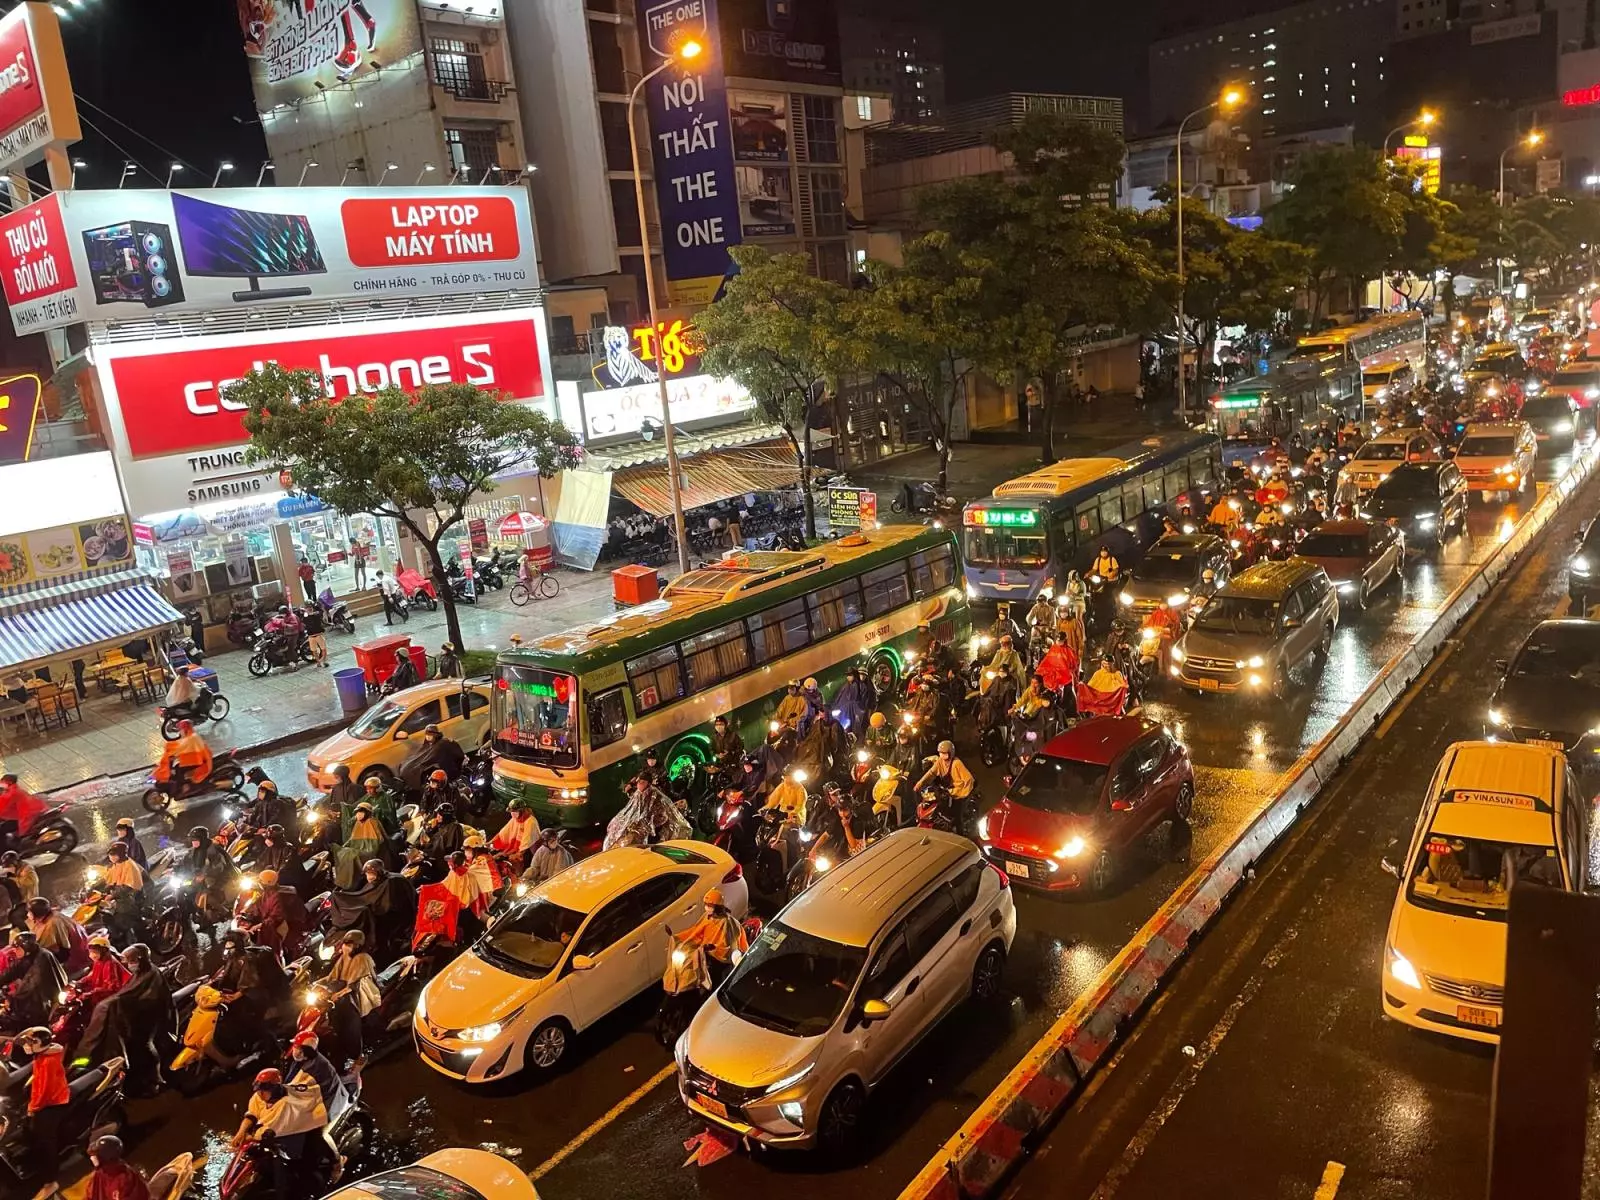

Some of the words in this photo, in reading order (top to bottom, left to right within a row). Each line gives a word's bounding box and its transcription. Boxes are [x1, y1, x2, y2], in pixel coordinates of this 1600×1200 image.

[651, 12, 673, 31] THE
[676, 2, 701, 21] ONE
[662, 71, 704, 113] NỘI
[658, 113, 719, 159] THẤT
[671, 170, 717, 203] THE
[391, 204, 479, 228] LAPTOP
[5, 224, 31, 258] THU
[29, 209, 48, 249] CŨ
[384, 230, 436, 258] MÁY
[440, 229, 494, 255] TÍNH
[676, 217, 724, 248] ONE
[13, 255, 36, 295] ĐỔI
[32, 251, 60, 290] MỚI
[353, 274, 387, 291] CHÍNH
[431, 272, 450, 286] TRẢ
[451, 273, 471, 285] GÓP
[493, 271, 512, 282] THU
[513, 268, 526, 281] CŨ
[16, 307, 40, 327] NHANH
[42, 297, 58, 321] TIẾT
[58, 295, 78, 319] KIỆM
[187, 451, 244, 472] TRUNG
[187, 479, 261, 501] SAMSUNG
[1473, 793, 1514, 804] VINASUN
[1514, 799, 1533, 807] TAXI
